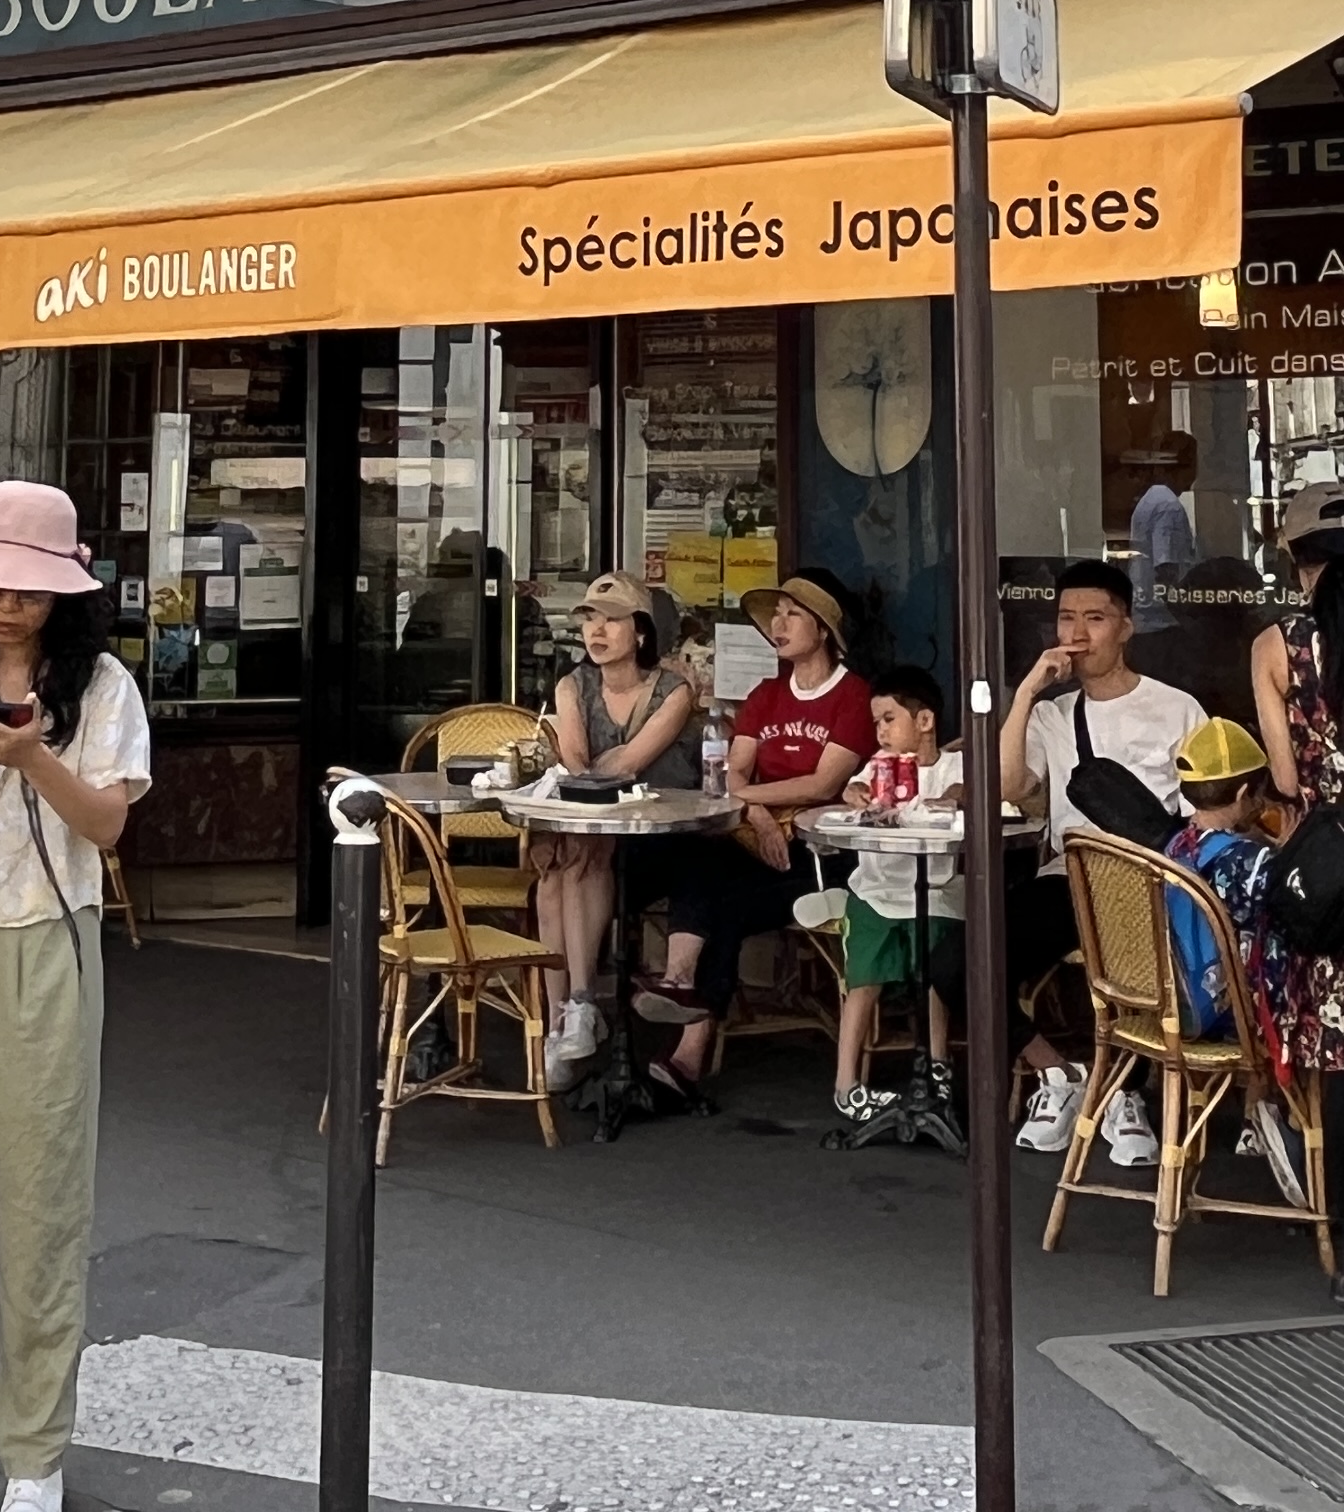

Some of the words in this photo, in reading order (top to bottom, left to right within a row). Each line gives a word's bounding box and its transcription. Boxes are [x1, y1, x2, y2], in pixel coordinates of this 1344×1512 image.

[517, 201, 787, 287] Spécialités
[34, 247, 109, 324] aki
[121, 241, 298, 303] BOULANGER
[1203, 305, 1268, 330] Pain
[1150, 356, 1183, 378] et
[1194, 350, 1259, 376] Cuit
